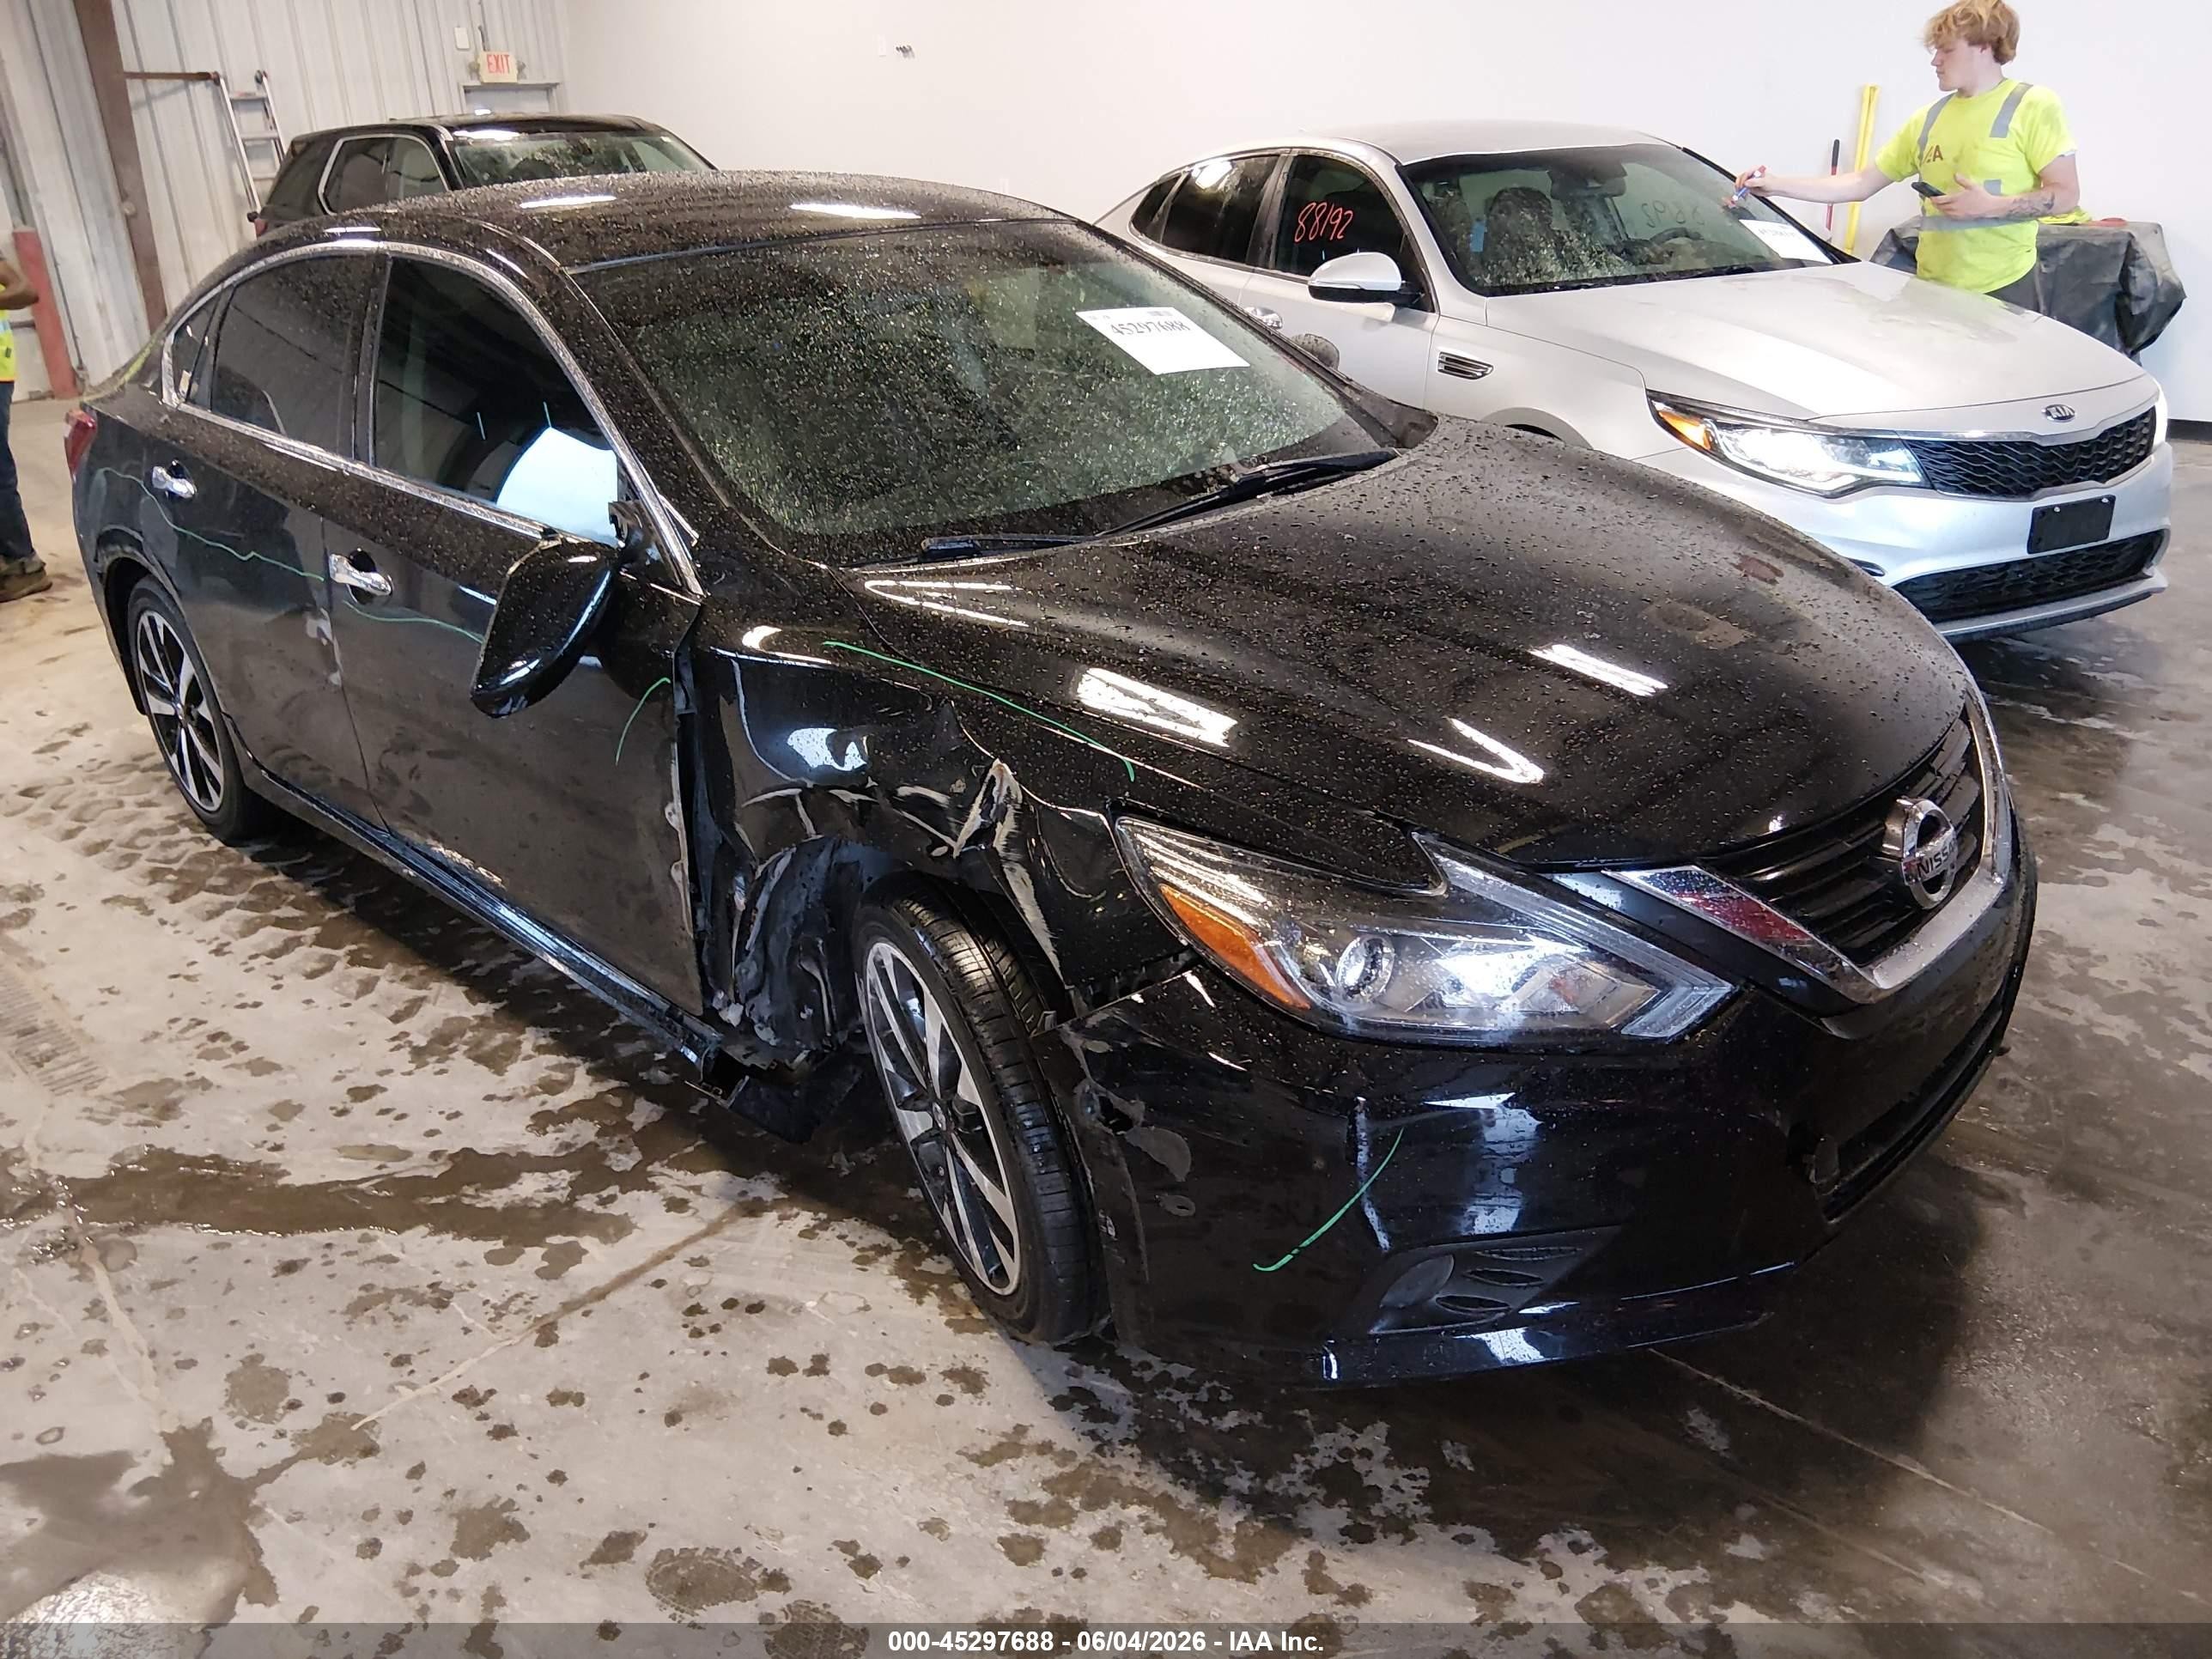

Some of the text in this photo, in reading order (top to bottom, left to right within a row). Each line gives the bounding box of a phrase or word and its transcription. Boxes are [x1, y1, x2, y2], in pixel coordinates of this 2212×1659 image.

[486, 54, 510, 74] EXIT
[1294, 202, 1353, 243] 88192
[2046, 405, 2075, 419] KIA
